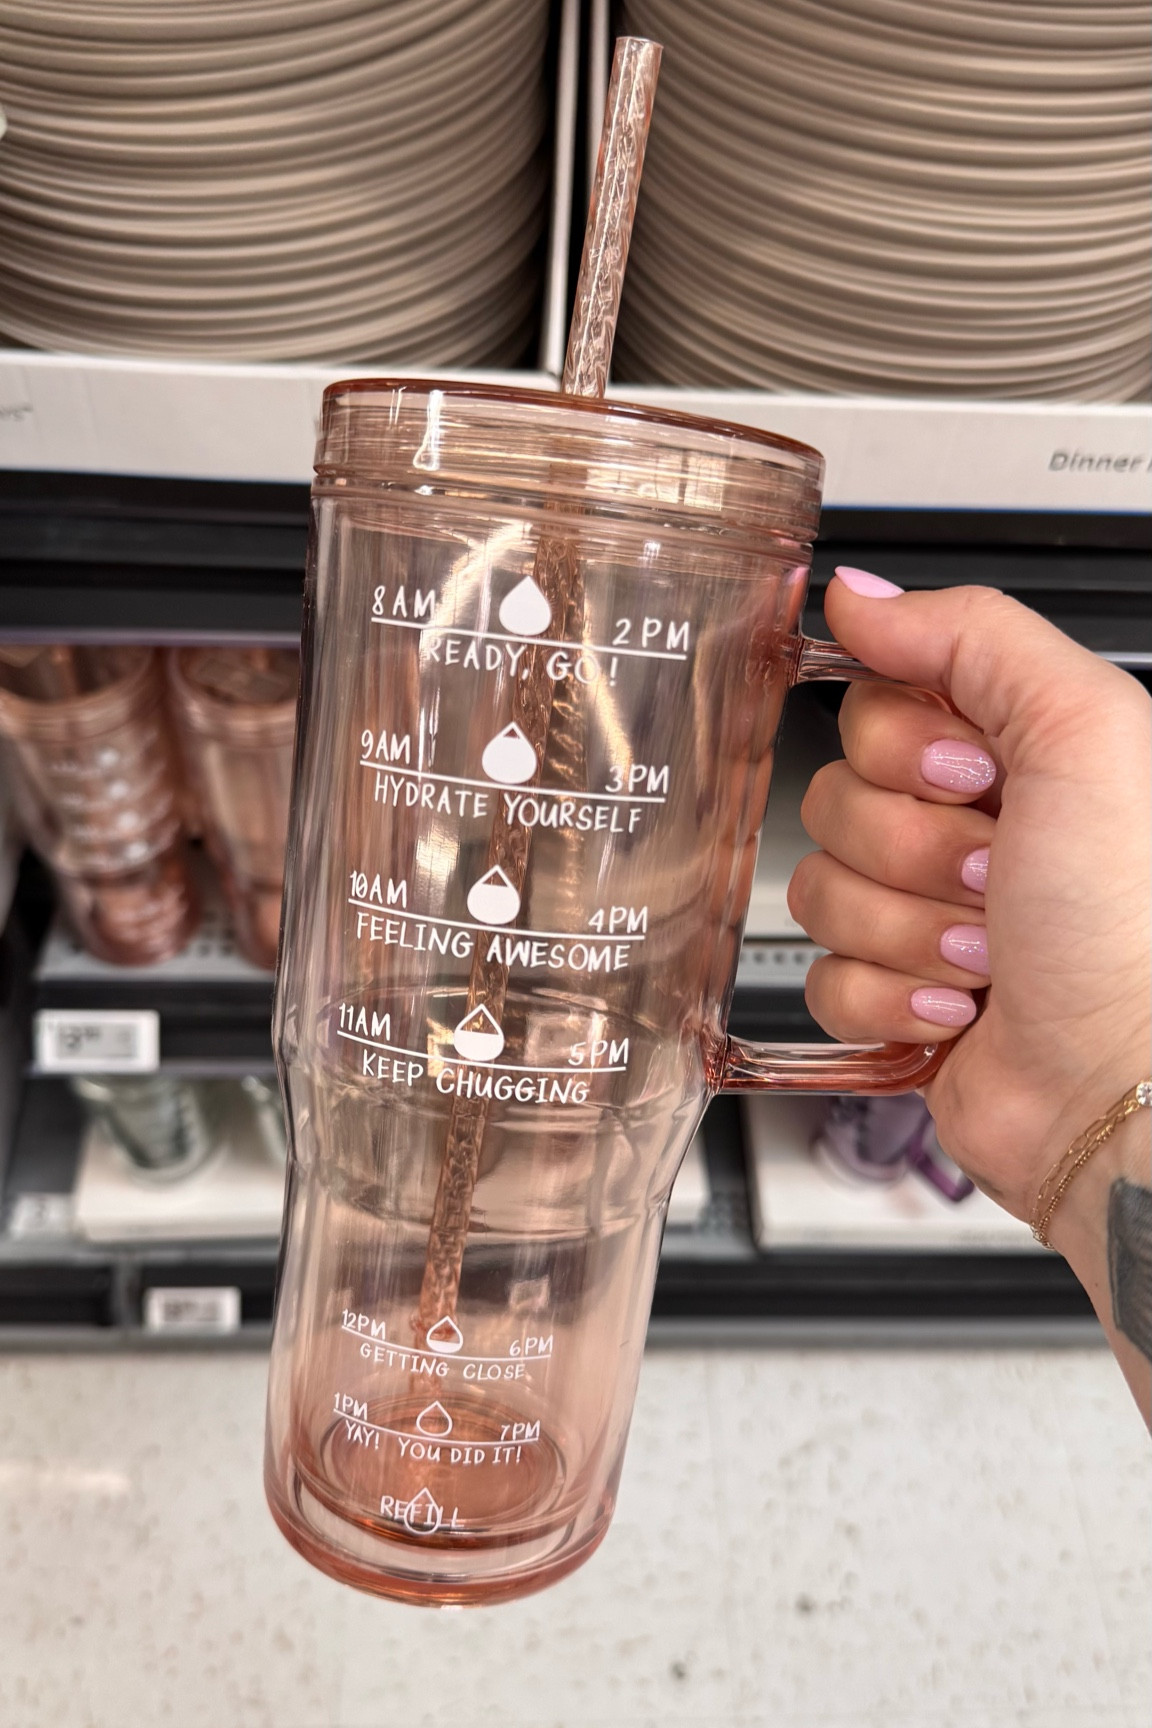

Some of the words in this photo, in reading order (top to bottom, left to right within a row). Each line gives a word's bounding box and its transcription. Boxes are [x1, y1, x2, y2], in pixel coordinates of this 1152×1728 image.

[1048, 447, 1146, 473] Dinner
[425, 639, 530, 680] READY,
[361, 729, 411, 764] 9AM
[605, 764, 670, 794] 3PM
[374, 771, 489, 818] HYDRATE
[504, 793, 642, 834] YOURSELF
[349, 869, 407, 908] 10AM
[588, 905, 648, 934] 4PM
[356, 912, 474, 958] FEELING
[486, 934, 631, 973] AWESOME
[338, 1002, 391, 1041] 11AM
[568, 1037, 630, 1066] 5PM
[362, 1049, 424, 1086] KEEP
[436, 1069, 590, 1104] CHUGGING
[342, 1308, 386, 1339] 12PM
[360, 1343, 450, 1377] GETTING
[463, 1363, 526, 1381] CLOSE
[509, 1334, 554, 1356] 6PM
[334, 1392, 368, 1421] 1PM
[345, 1420, 380, 1450] YAY!
[398, 1437, 440, 1462] YOU
[451, 1447, 485, 1465] DID
[492, 1445, 522, 1464] IT!
[501, 1420, 540, 1441] 7PM
[380, 1495, 465, 1528] REFILL
